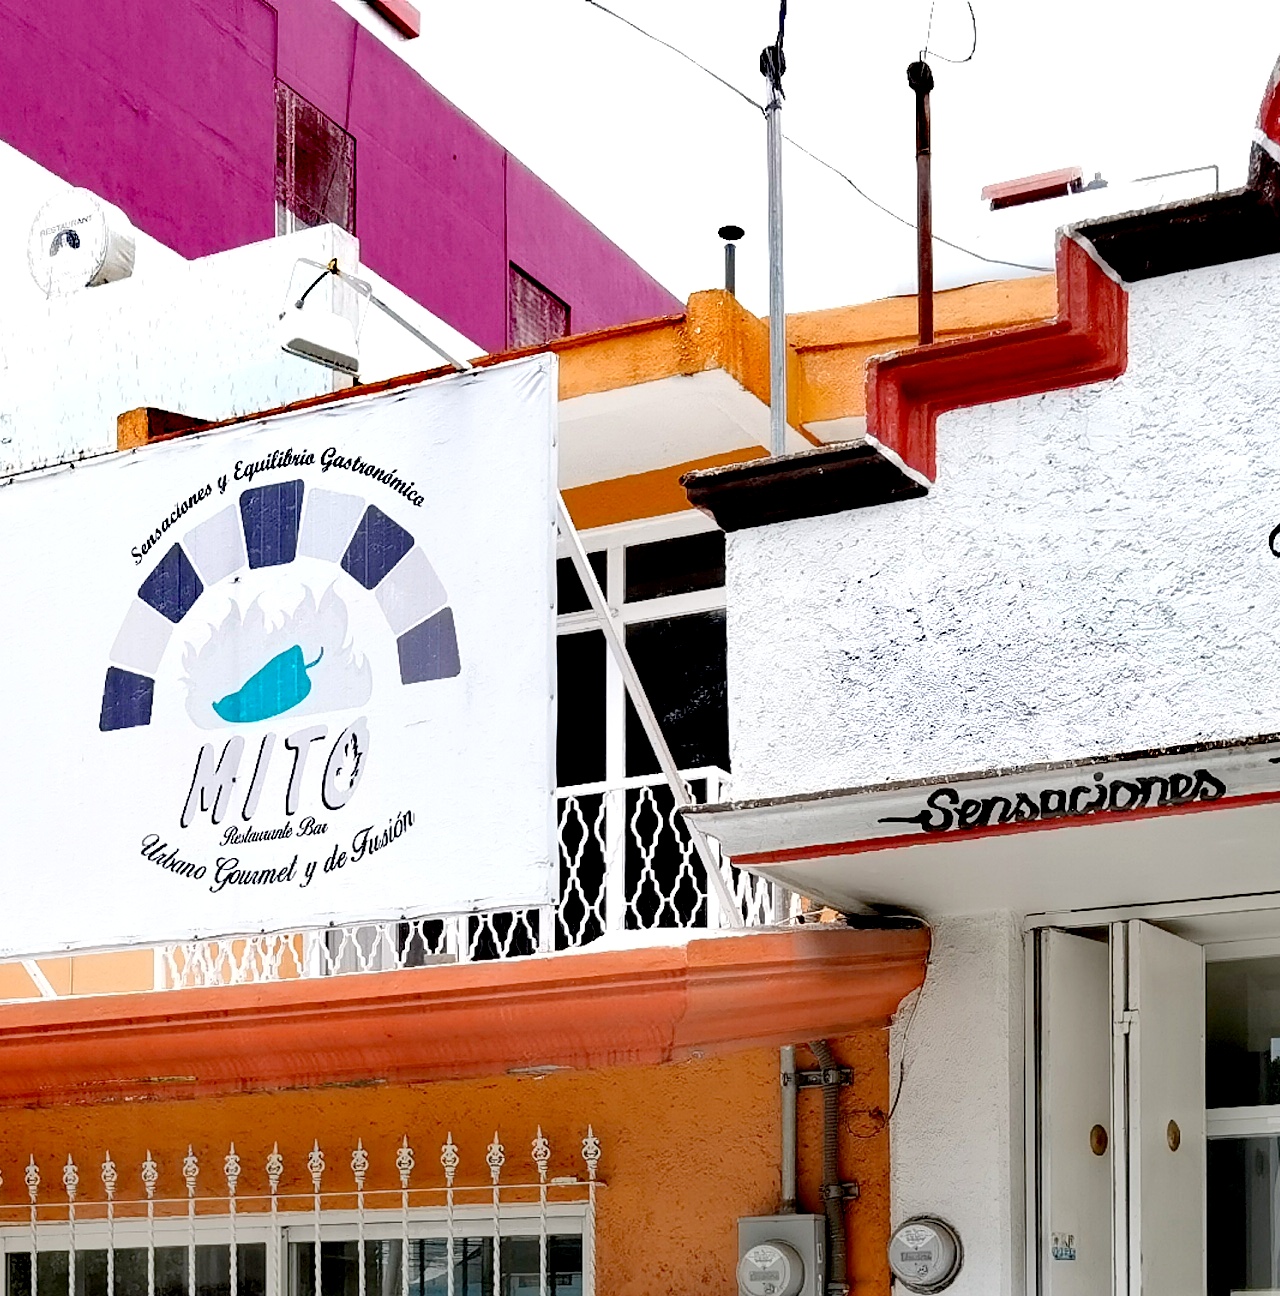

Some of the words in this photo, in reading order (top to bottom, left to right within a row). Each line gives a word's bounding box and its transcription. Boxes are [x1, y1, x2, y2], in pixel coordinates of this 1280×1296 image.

[131, 484, 212, 565] Sensaciones
[217, 473, 229, 494] y
[234, 447, 316, 482] Equilibrio
[320, 447, 425, 508] Gastronómico
[180, 716, 370, 828] MITO
[916, 772, 1226, 832] Sensaciones
[141, 834, 207, 880] Urbano
[209, 855, 298, 893] Gourmet
[299, 860, 318, 888] y
[323, 845, 348, 873] de
[350, 810, 415, 863] Fusión
[220, 820, 292, 846] Restaurante
[296, 816, 328, 837] Bar
